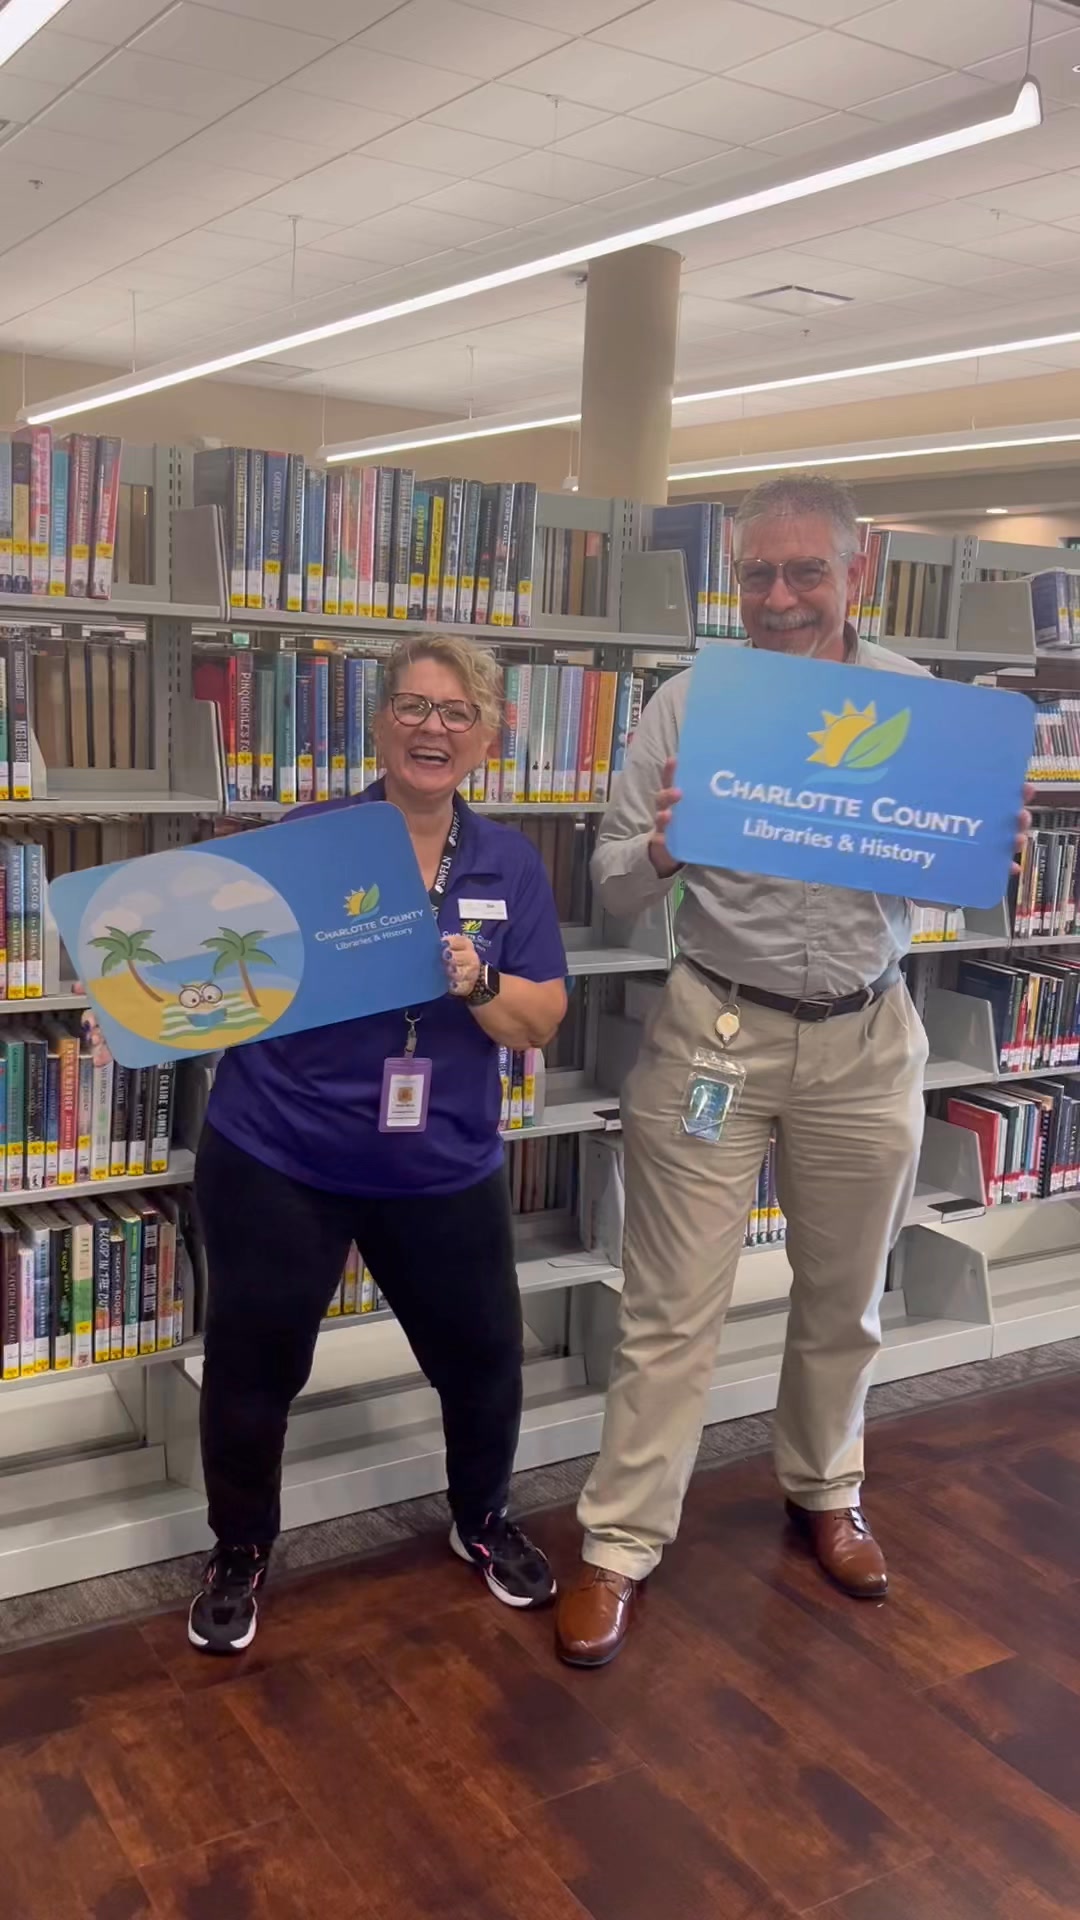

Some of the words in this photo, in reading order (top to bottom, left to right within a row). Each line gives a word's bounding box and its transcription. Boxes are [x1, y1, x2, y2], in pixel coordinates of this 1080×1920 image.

[633, 684, 642, 705] FIRE
[709, 770, 862, 817] CHARLOTTE
[871, 797, 984, 838] COUNTY
[743, 818, 832, 850] Libraries
[836, 834, 854, 853] &
[859, 837, 936, 869] History
[314, 920, 377, 942] CHARLOTTE
[379, 909, 424, 927] COUNTY
[335, 936, 373, 951] Libraries
[158, 1074, 170, 1105] CLAIRE
[99, 1227, 110, 1258] BLOOD
[99, 1259, 109, 1270] IN
[99, 1272, 110, 1289] THE
